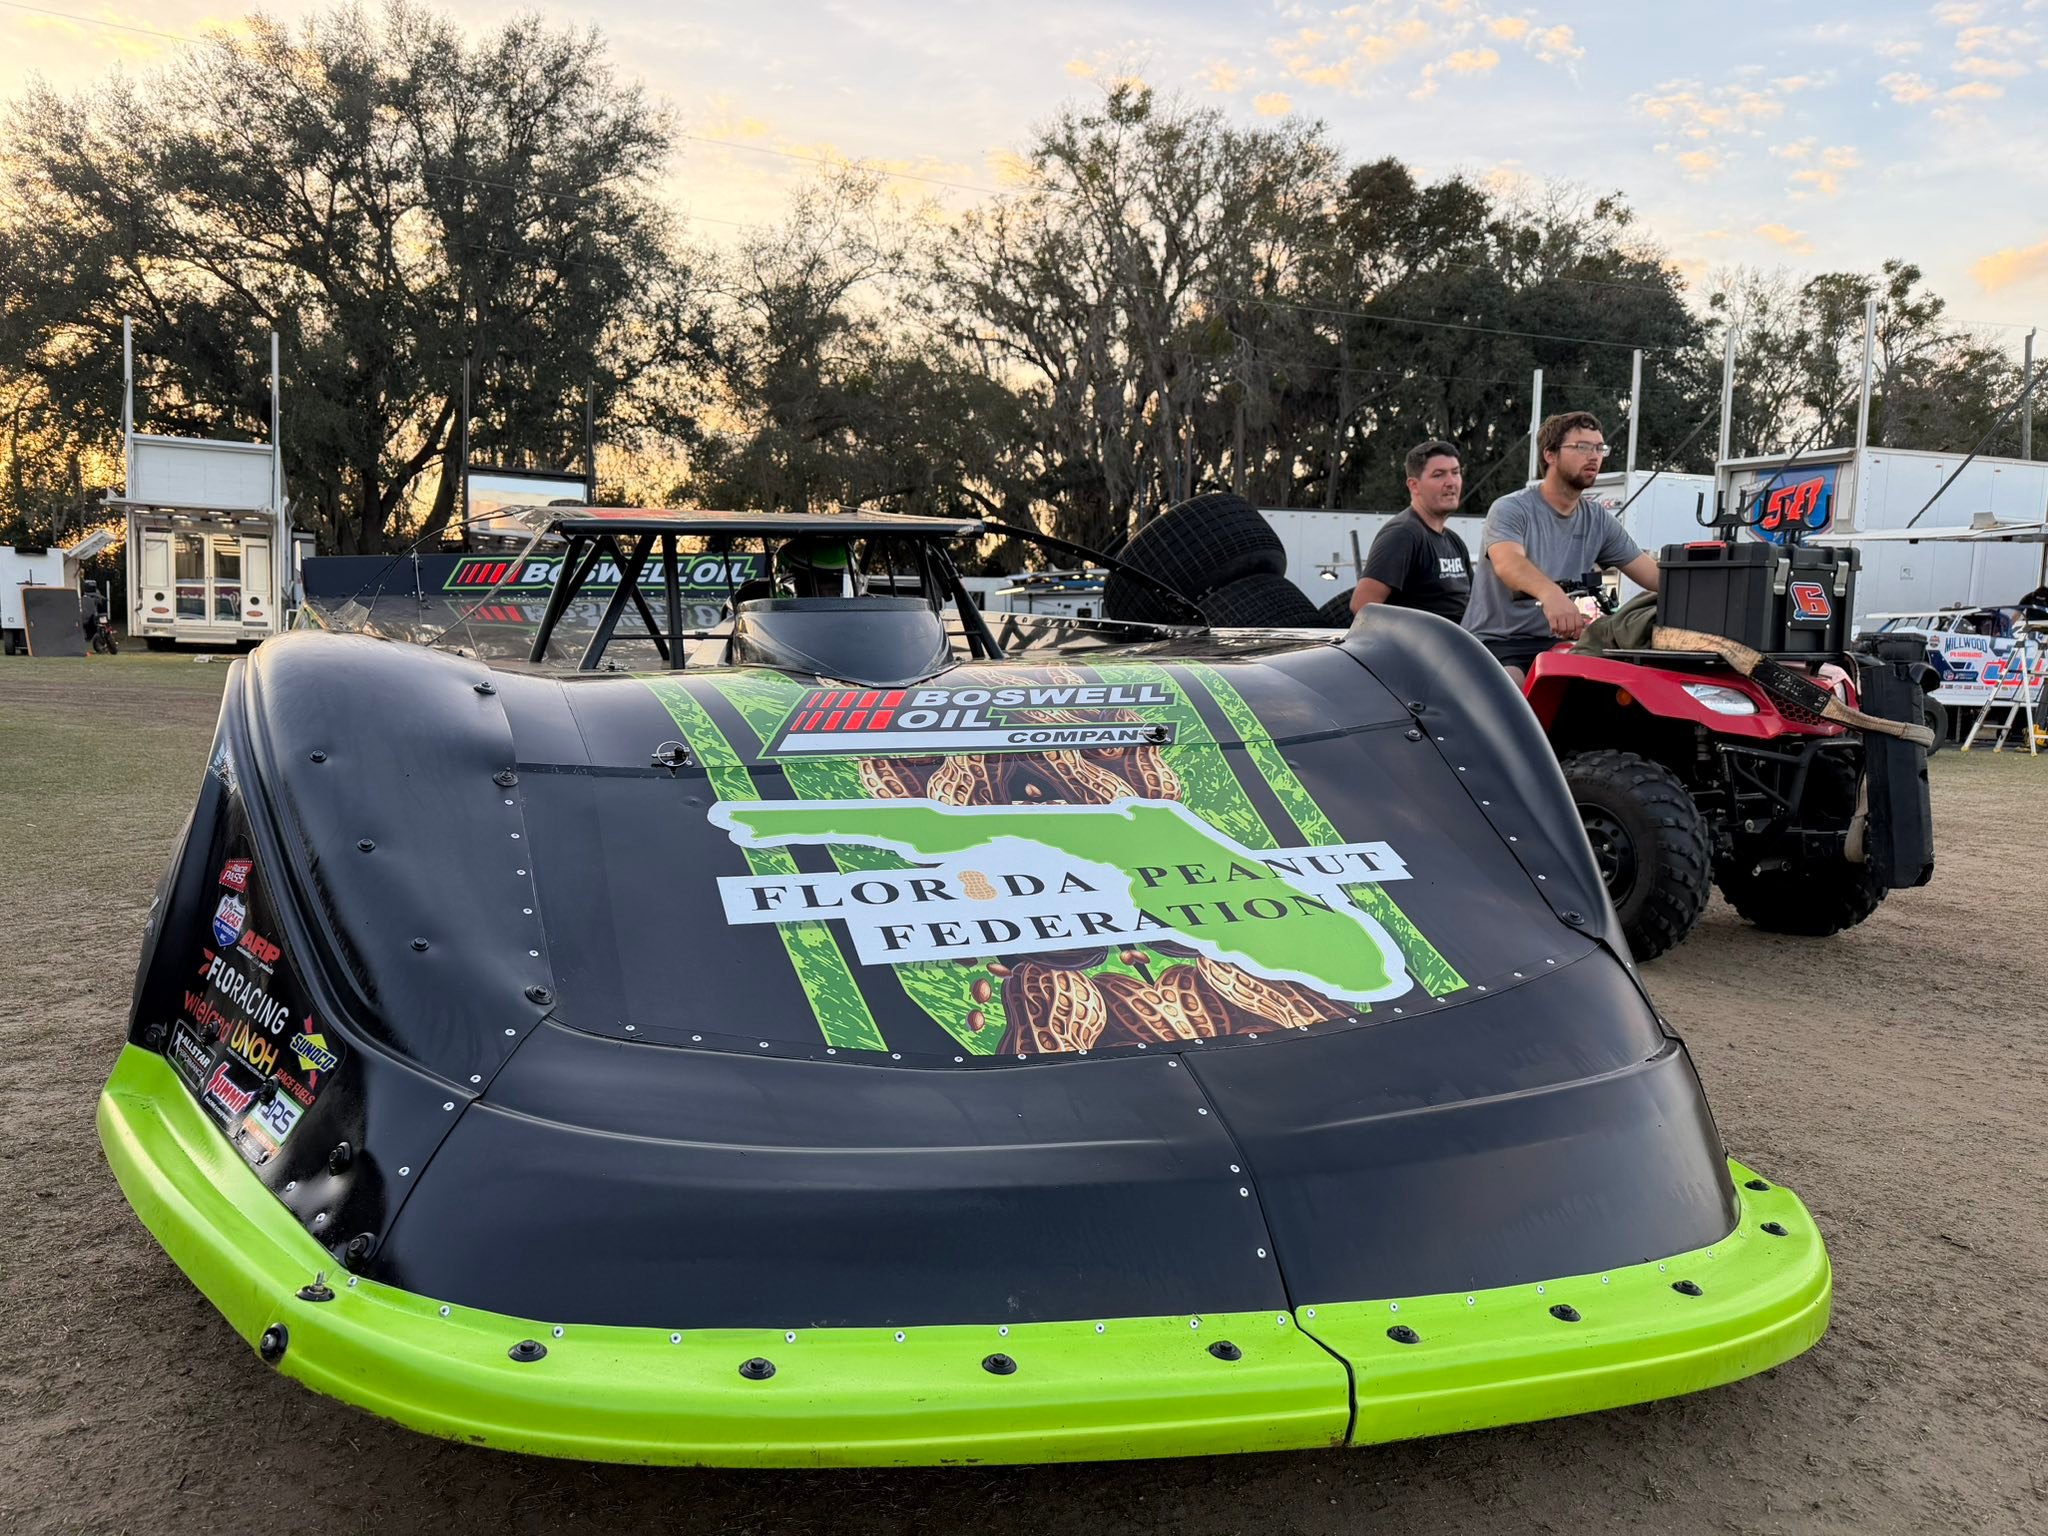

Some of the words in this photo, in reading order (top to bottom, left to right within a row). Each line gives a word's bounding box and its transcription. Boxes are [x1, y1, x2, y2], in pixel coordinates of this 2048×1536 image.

[520, 562, 689, 583] BSWELL
[692, 562, 747, 583] OIL
[1791, 583, 1830, 618] 6
[1945, 637, 1988, 653] MILLWOOD
[911, 686, 1166, 707] BOSWELL
[897, 709, 991, 728] OIL
[1007, 729, 1160, 744] COMPAN
[222, 870, 246, 885] PASS
[745, 870, 1101, 911] FLORDA
[1132, 851, 1386, 888] PEANUT
[219, 909, 241, 928] LUCAS
[874, 893, 1337, 951] FEDERATION
[240, 929, 280, 965] ARP
[206, 955, 289, 1035] FLORACING
[181, 1035, 210, 1068] ALLSTAR
[230, 1019, 279, 1076] UNOH
[290, 1034, 338, 1072] SUNOCO
[202, 1061, 257, 1116] SUMMIT
[276, 1067, 296, 1090] RACE
[292, 1082, 316, 1107] FUELS
